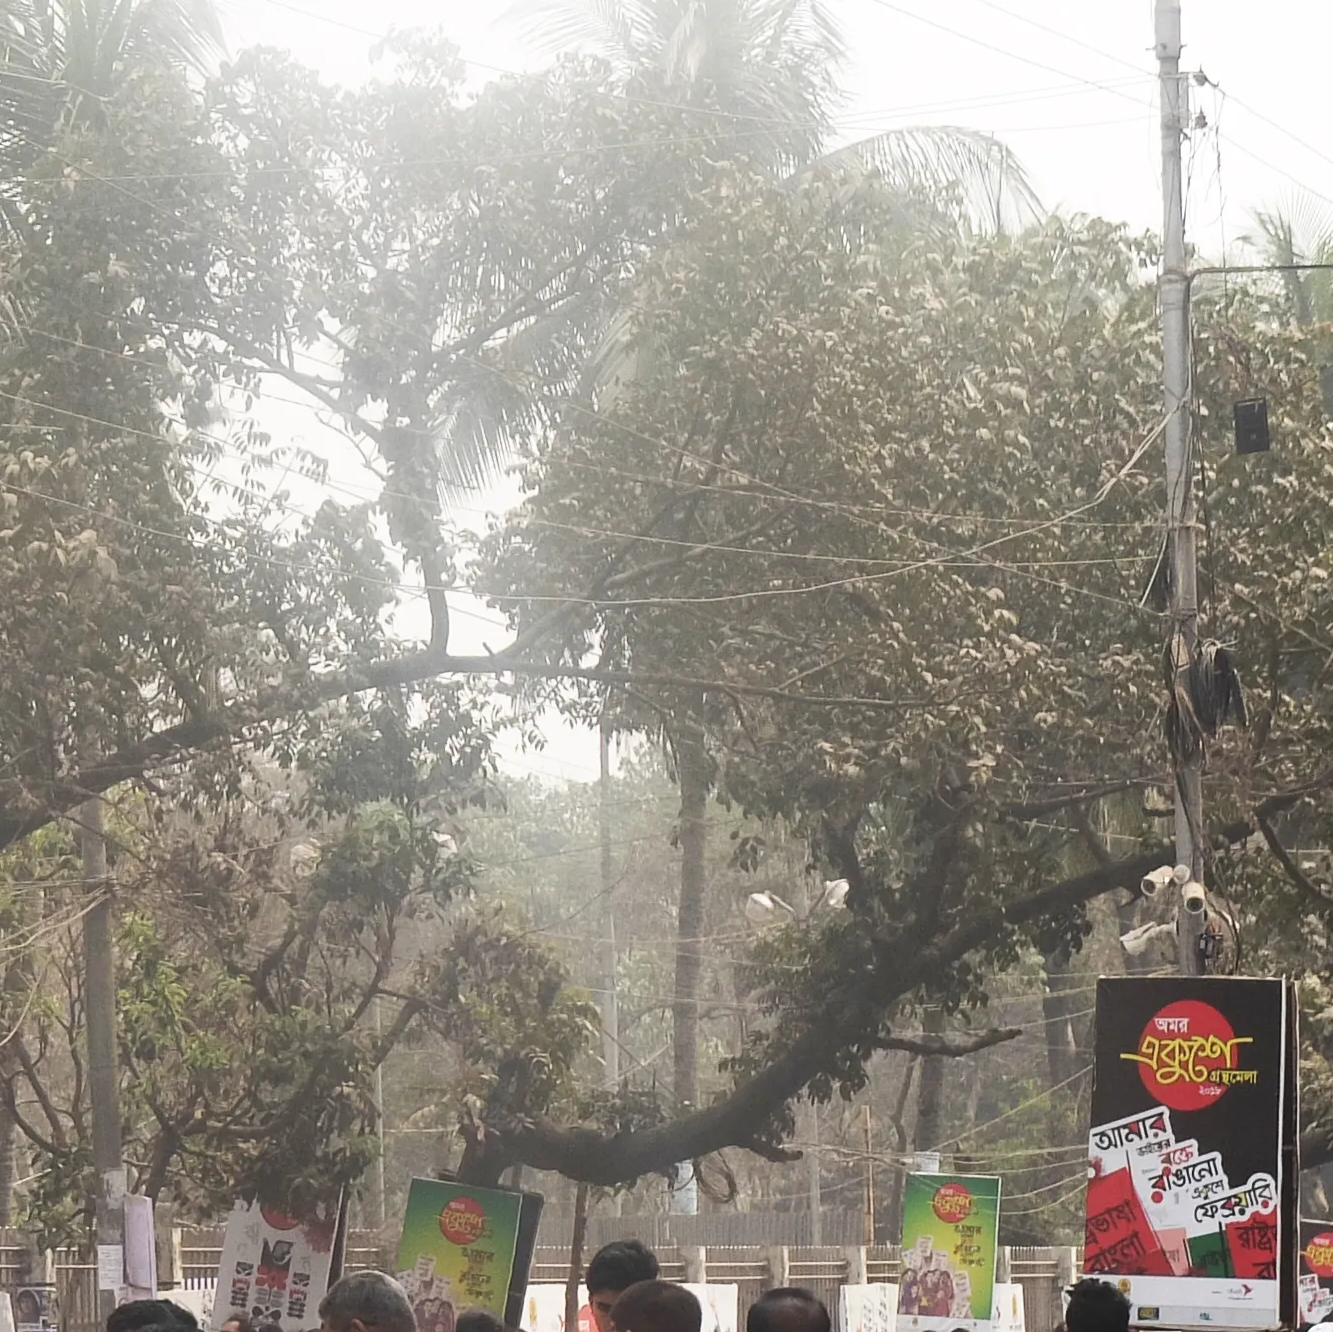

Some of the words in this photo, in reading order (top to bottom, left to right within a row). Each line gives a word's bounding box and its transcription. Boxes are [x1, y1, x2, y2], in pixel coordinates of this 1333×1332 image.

[1154, 1017, 1190, 1033] অমর
[1120, 1034, 1253, 1084] একুশে
[1093, 1112, 1167, 1150] আমার
[1148, 1157, 1220, 1204] রাঙানো
[1191, 1179, 1226, 1200] একুশে
